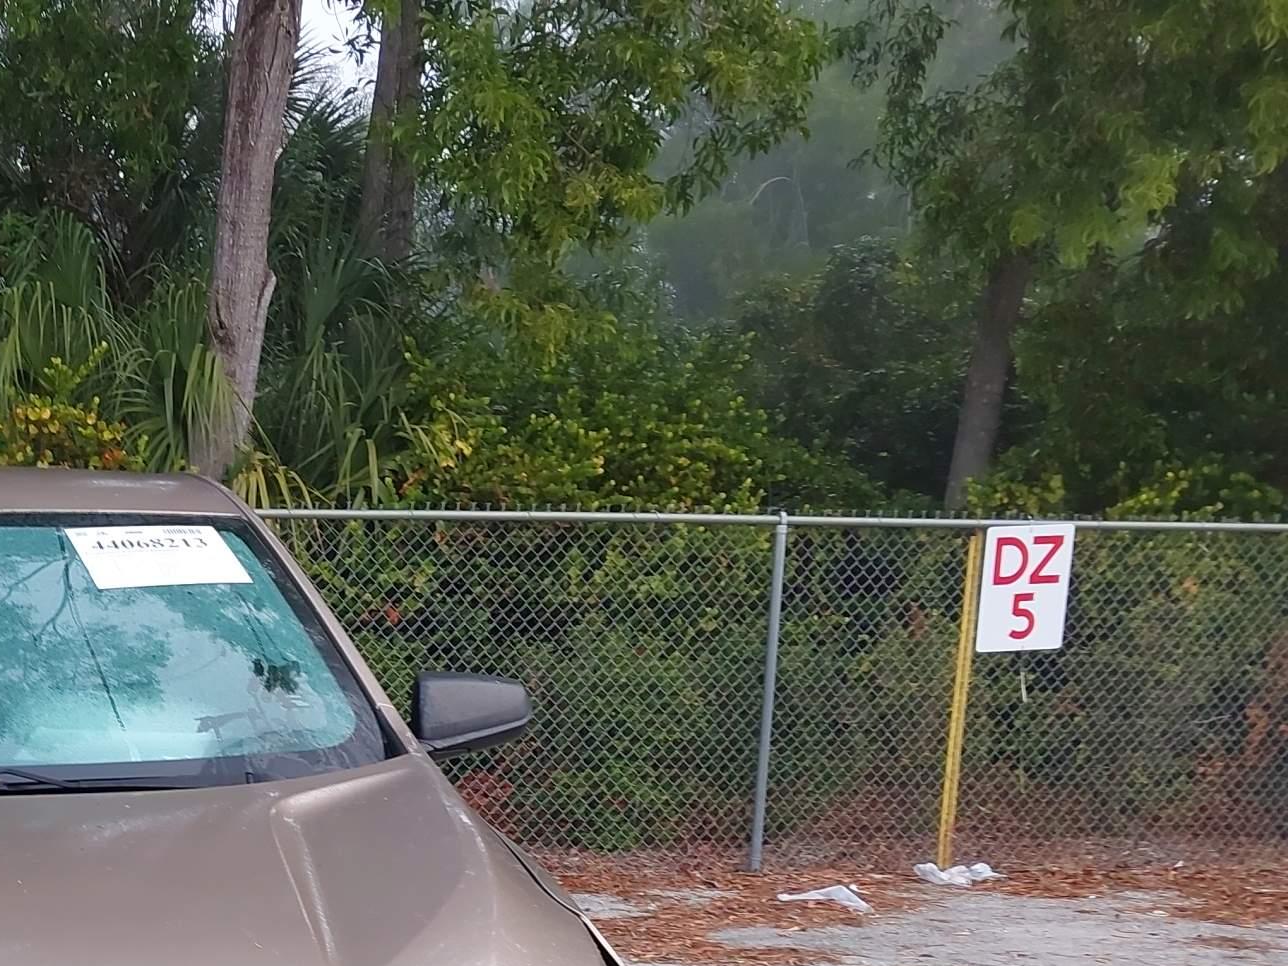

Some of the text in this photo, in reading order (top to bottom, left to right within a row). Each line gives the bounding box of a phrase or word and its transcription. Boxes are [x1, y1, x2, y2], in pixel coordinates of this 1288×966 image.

[91, 536, 209, 551] 44068213
[992, 535, 1065, 586] DZ
[1008, 592, 1036, 640] 5
